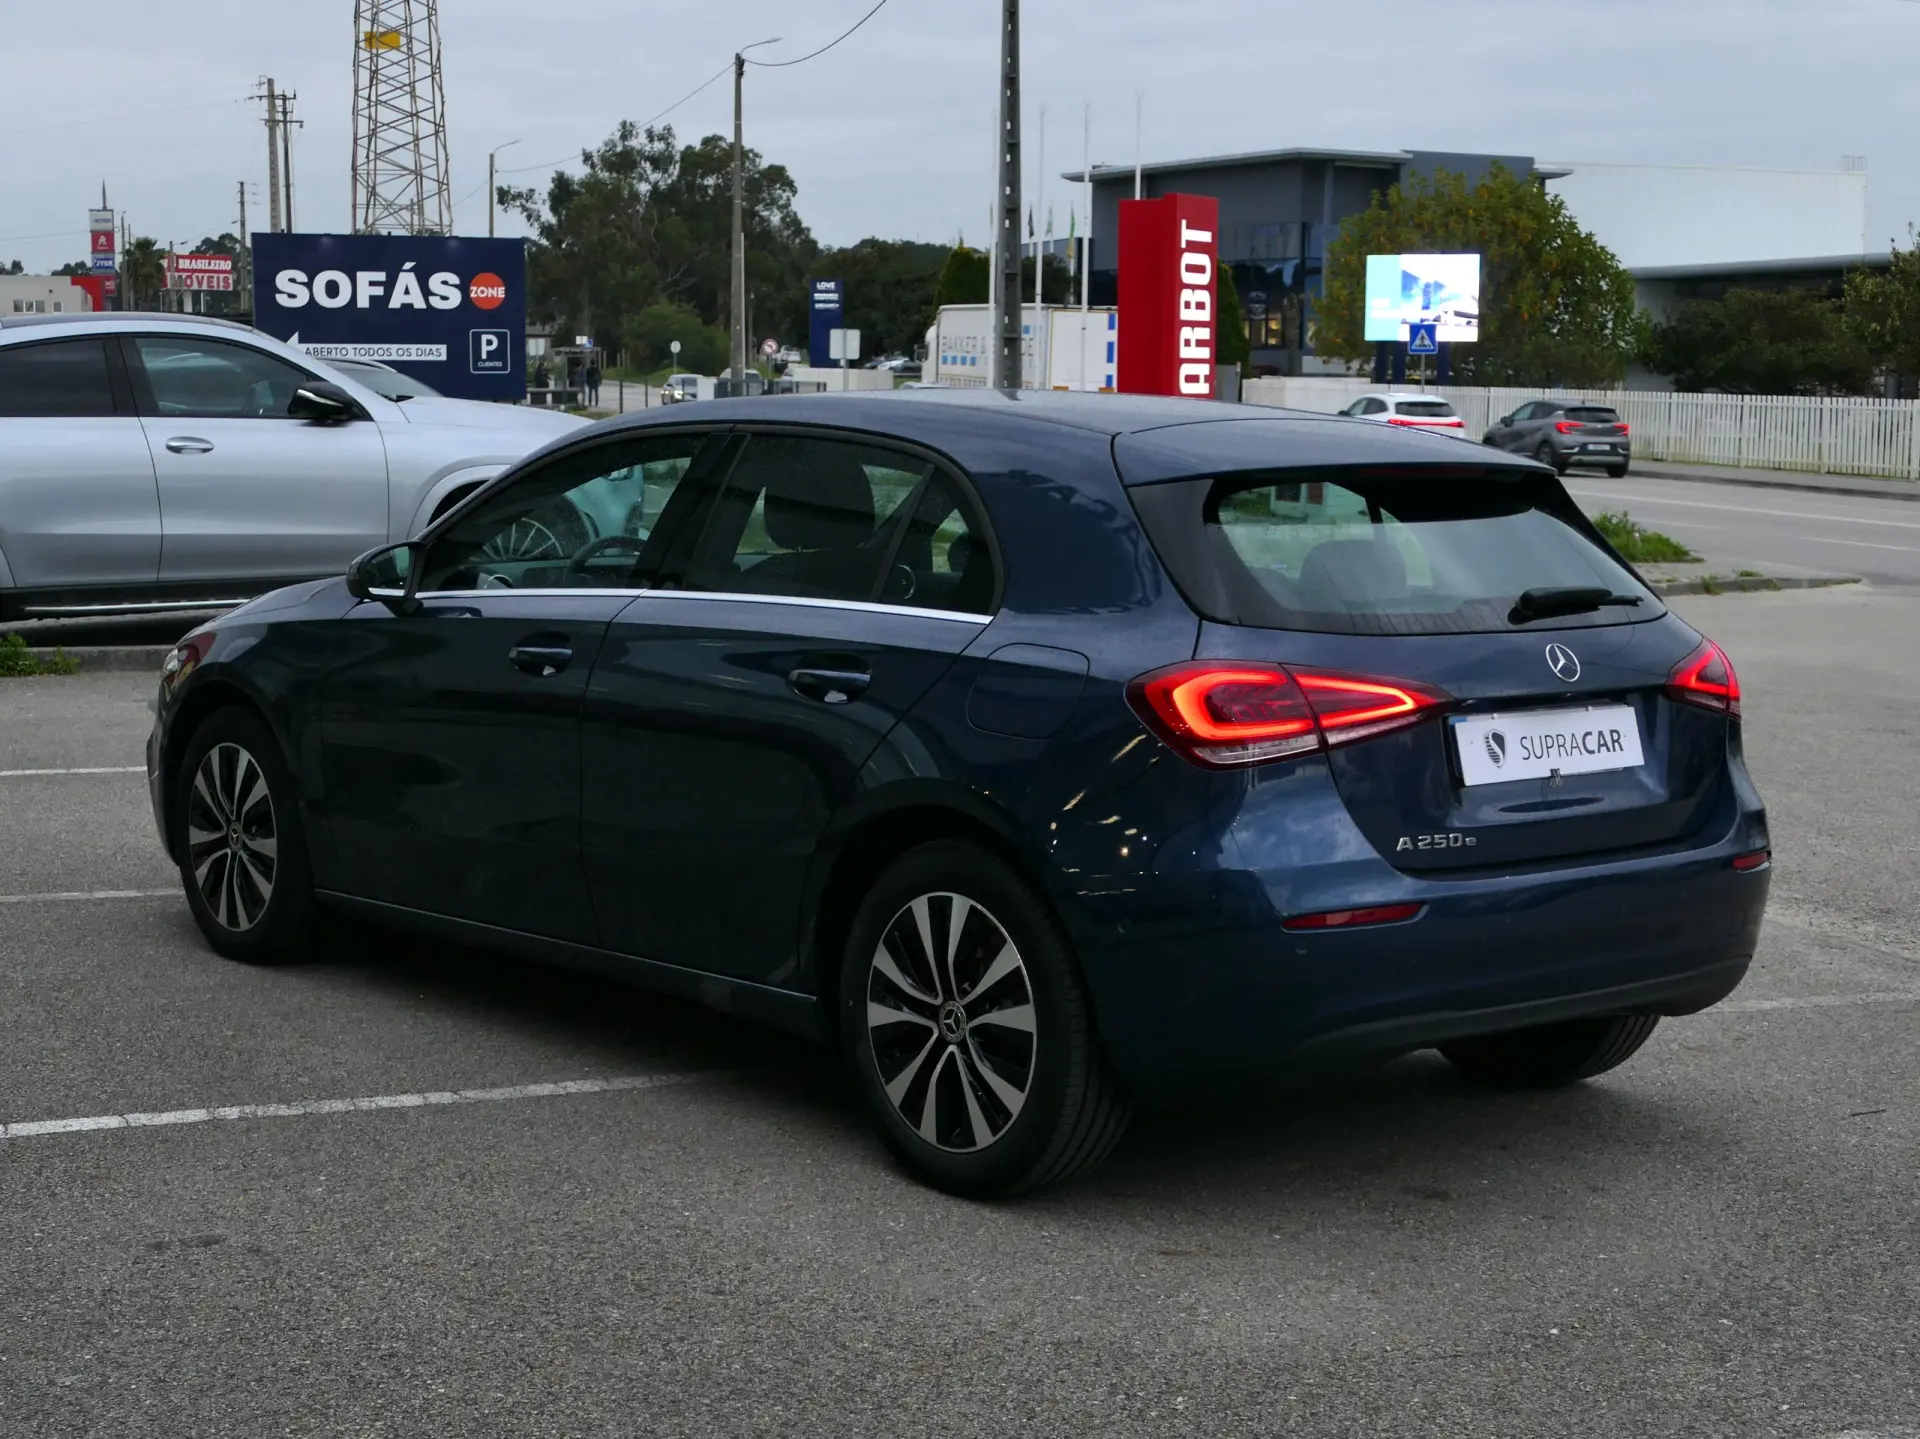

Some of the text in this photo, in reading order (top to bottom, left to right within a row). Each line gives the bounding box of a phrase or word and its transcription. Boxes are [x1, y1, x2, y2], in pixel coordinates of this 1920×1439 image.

[178, 258, 232, 271] BRASILEIRO
[275, 261, 462, 310] SOFÁS
[470, 286, 506, 298] ZONE
[1179, 219, 1212, 395] ARBOT
[305, 347, 442, 358] ABERTO TODOS OS DIAS
[480, 334, 499, 359] P
[1519, 729, 1624, 761] SUPRACAR
